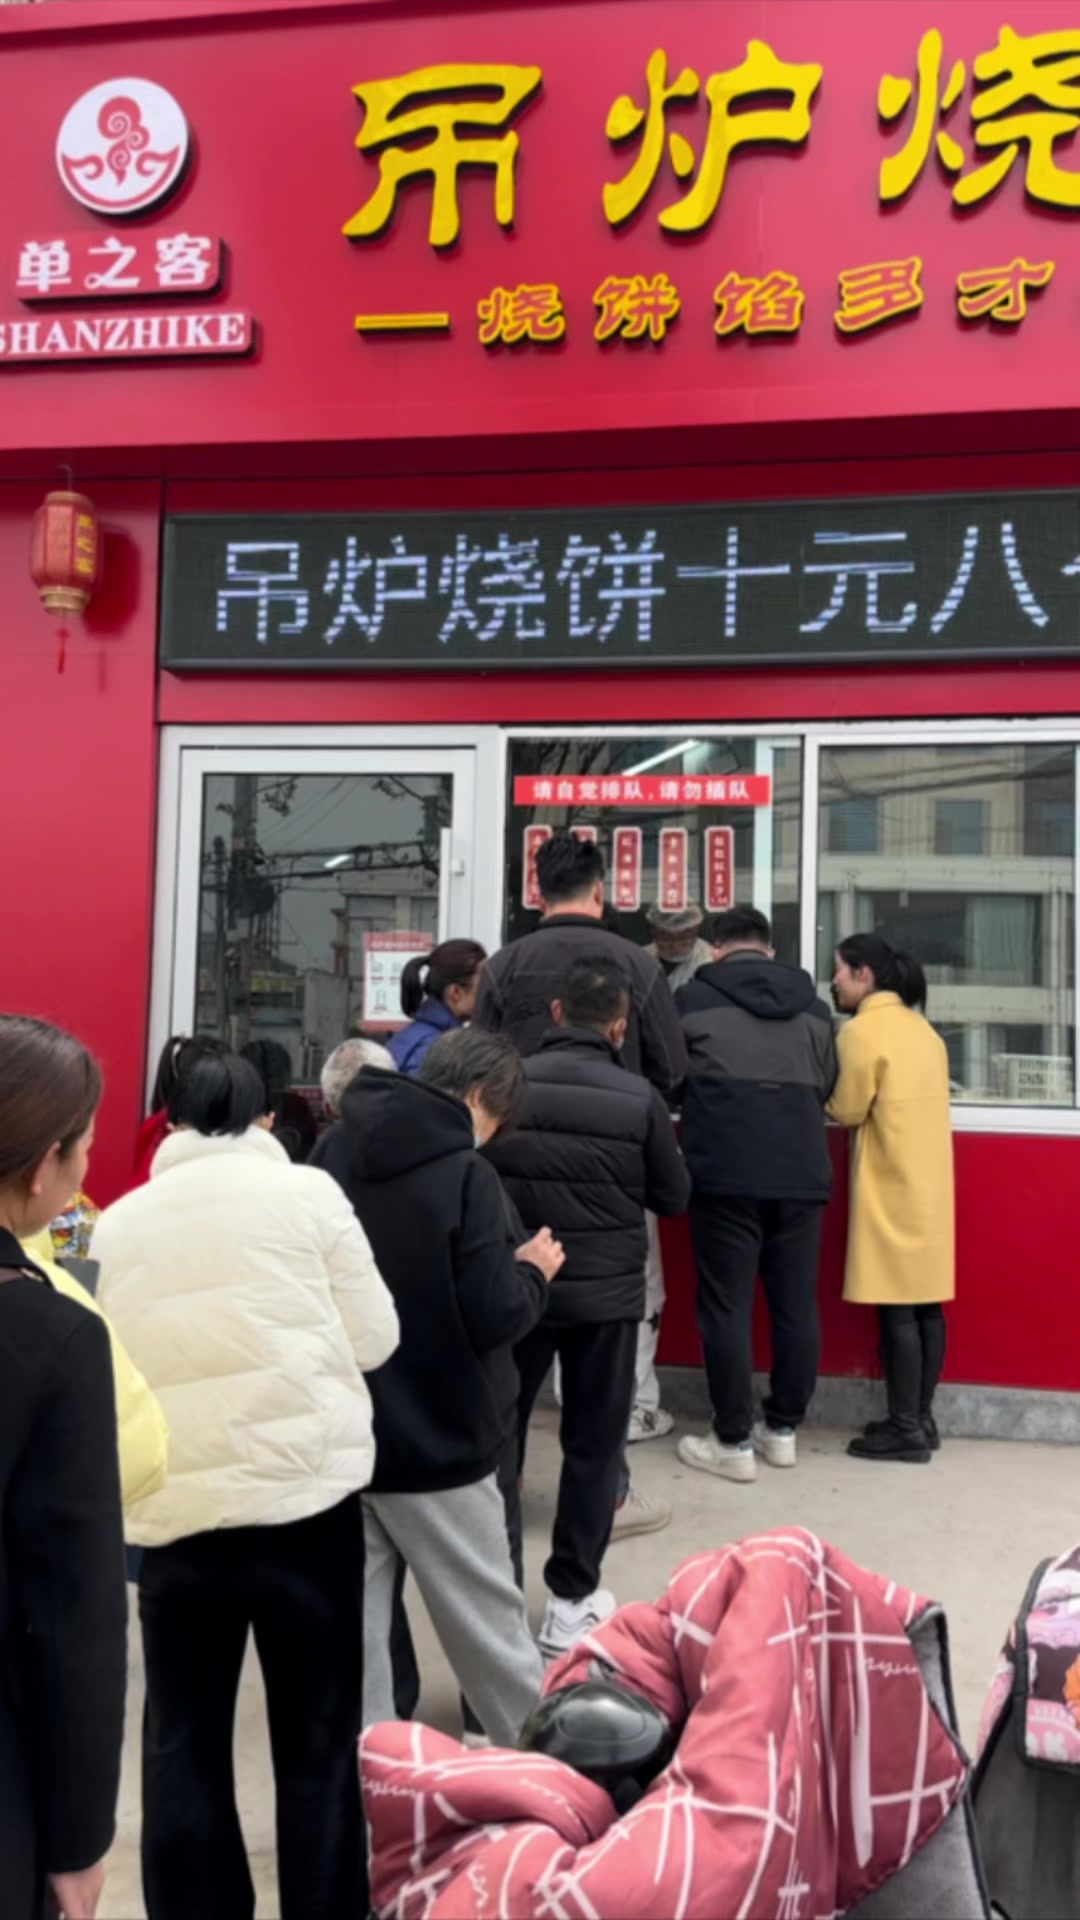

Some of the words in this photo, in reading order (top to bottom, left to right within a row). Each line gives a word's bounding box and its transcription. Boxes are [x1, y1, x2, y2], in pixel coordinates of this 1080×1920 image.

[342, 24, 1080, 247] 吊炉烧
[16, 233, 212, 292] 单之客
[0, 312, 246, 354] HANZHIKE
[216, 522, 1080, 645] 吊炉烧饼十元八
